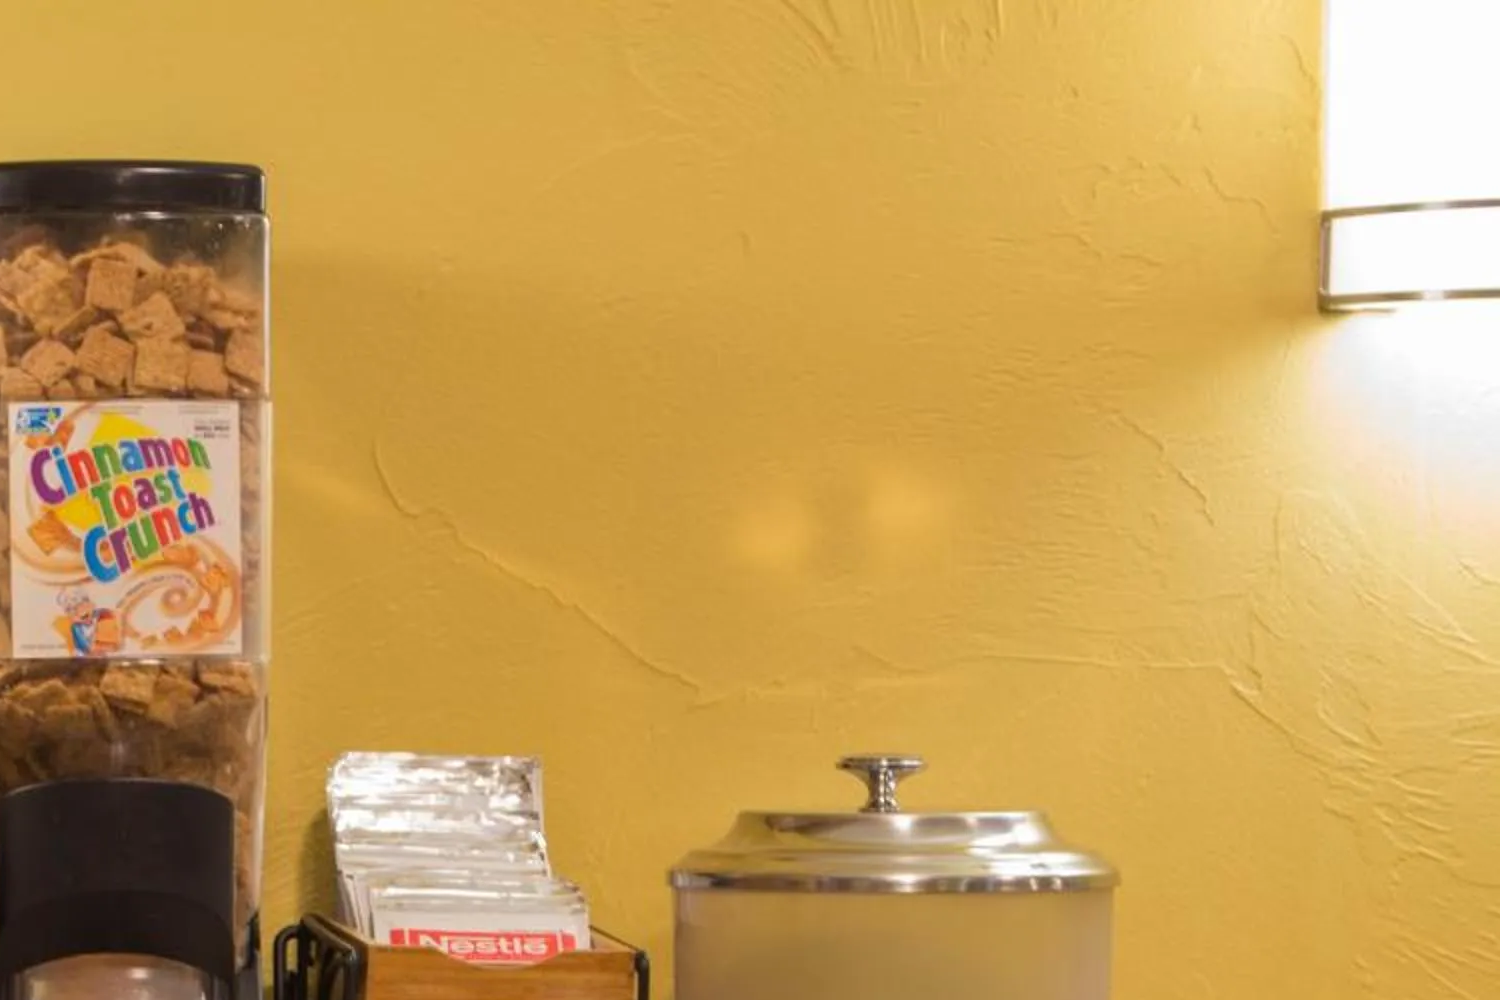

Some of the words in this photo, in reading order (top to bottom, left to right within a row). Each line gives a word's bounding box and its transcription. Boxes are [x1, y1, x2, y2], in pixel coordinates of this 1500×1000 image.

[31, 437, 211, 505] Cinnamon
[90, 468, 187, 529] Toast
[83, 491, 216, 583] Crunch
